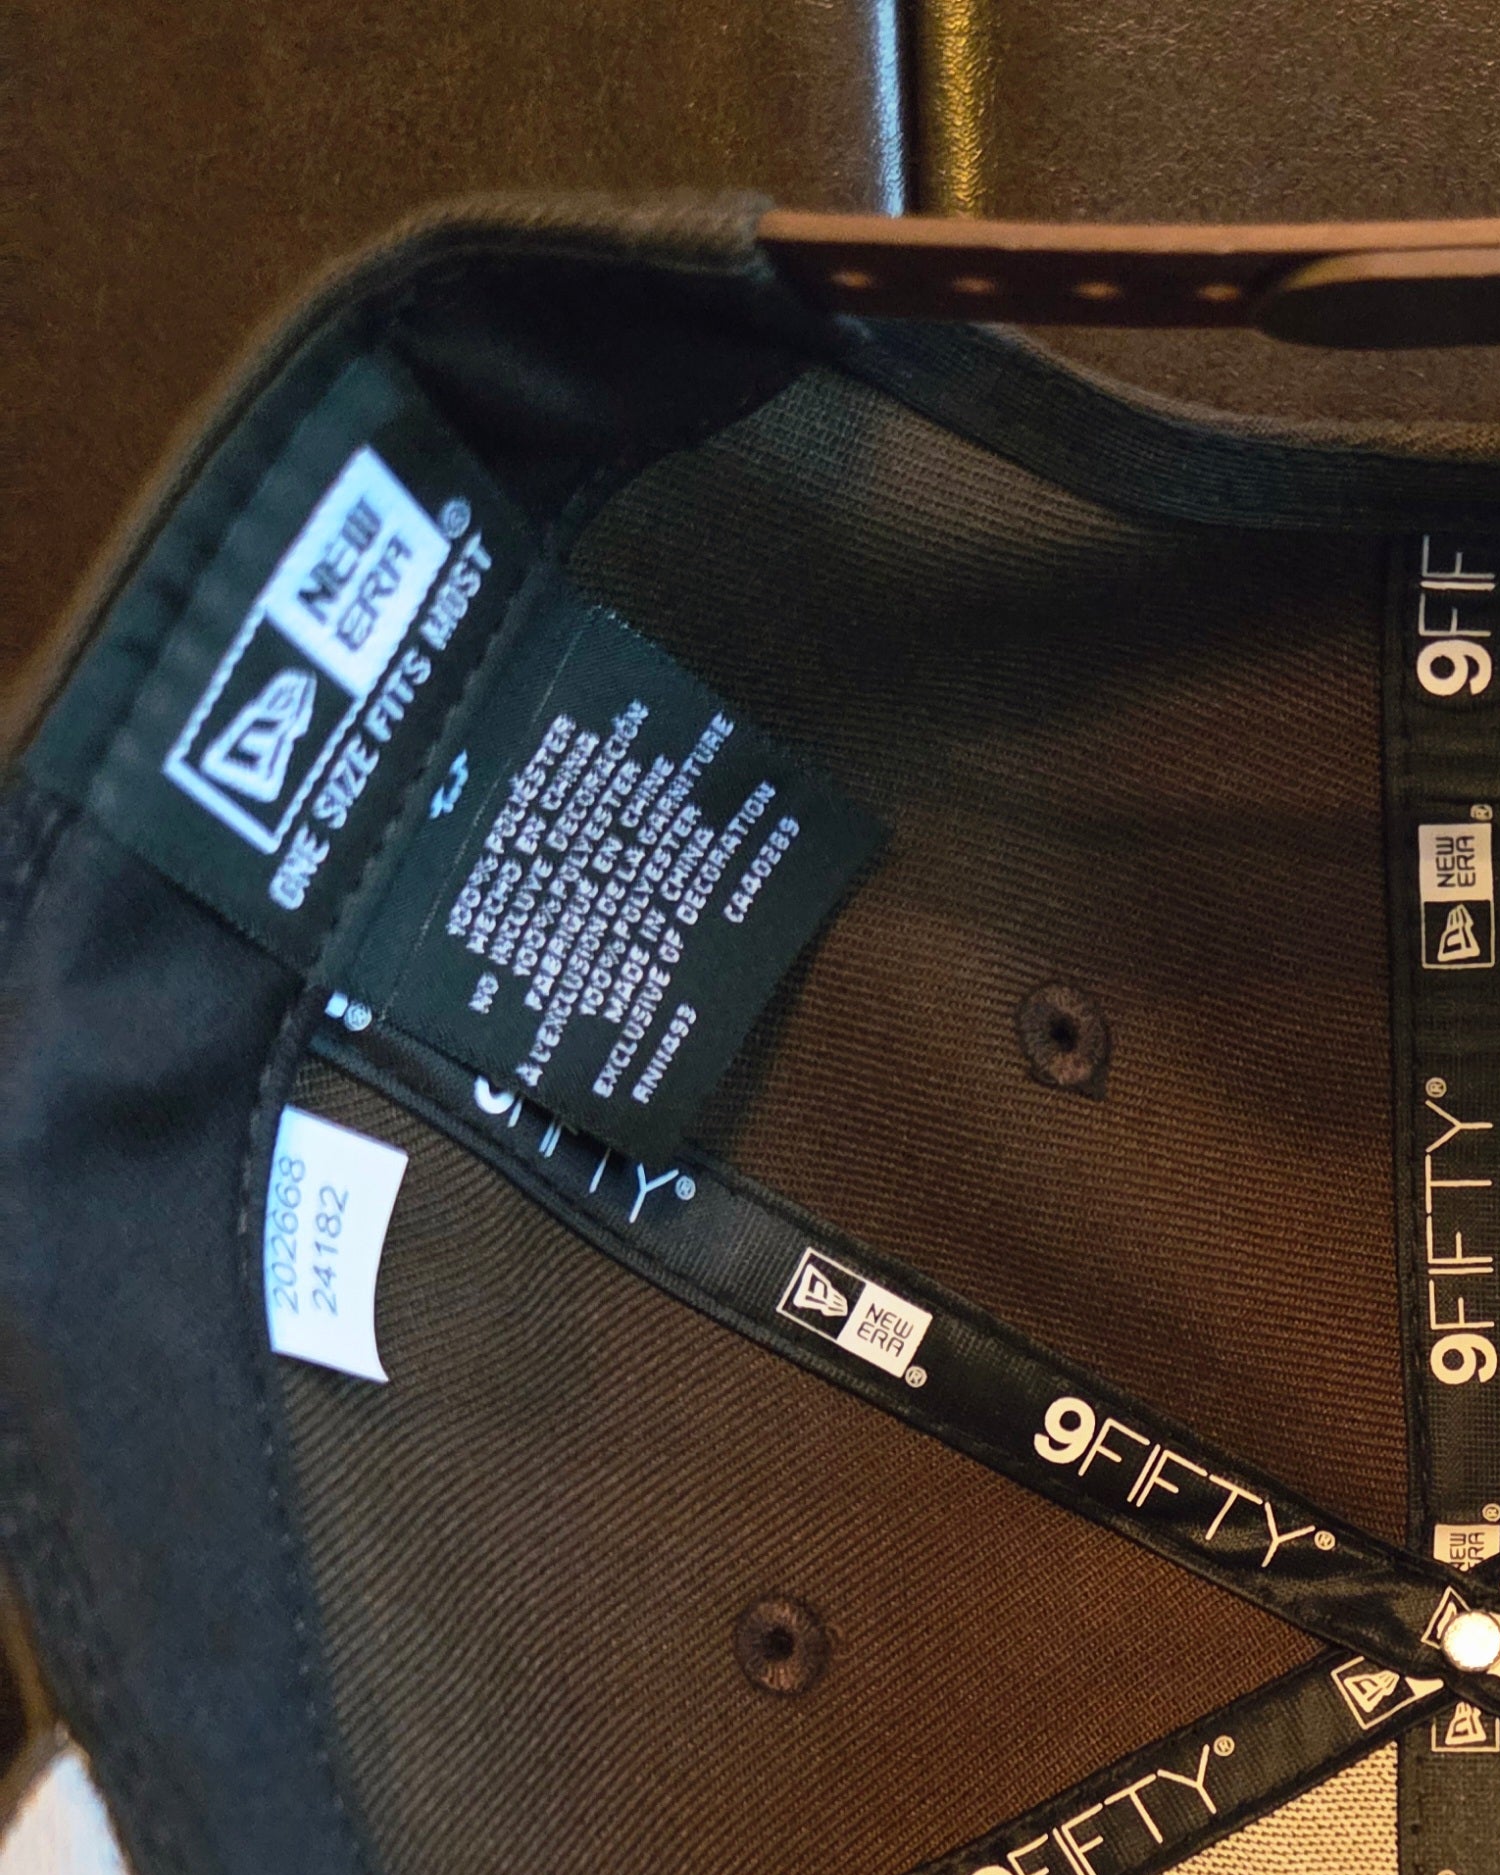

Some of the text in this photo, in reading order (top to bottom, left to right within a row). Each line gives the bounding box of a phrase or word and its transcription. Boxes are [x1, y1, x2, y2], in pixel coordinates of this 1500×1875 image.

[297, 497, 381, 621] NEW
[335, 534, 411, 651] ERA
[269, 533, 490, 909] ONE SIZE FITS MOST
[637, 712, 733, 844] GARNITURE
[466, 731, 599, 953] HECHO EN CHINA
[512, 760, 641, 975] 100% POLYESTER
[592, 836, 622, 872] EN
[620, 755, 674, 827] CHINE
[1435, 836, 1456, 888] NEW
[1456, 836, 1477, 888] ERA
[445, 854, 498, 935] 100%
[579, 805, 701, 1015] 100% POLYESTER
[593, 782, 775, 1097] EXCLUSIVE OF DECORATION
[603, 827, 714, 1022] MADE IN CHINA
[468, 973, 498, 1013] NO
[272, 1156, 305, 1314] 202668
[312, 1186, 350, 1317] 24182
[857, 1321, 905, 1357] ERA
[865, 1303, 914, 1340] NEW
